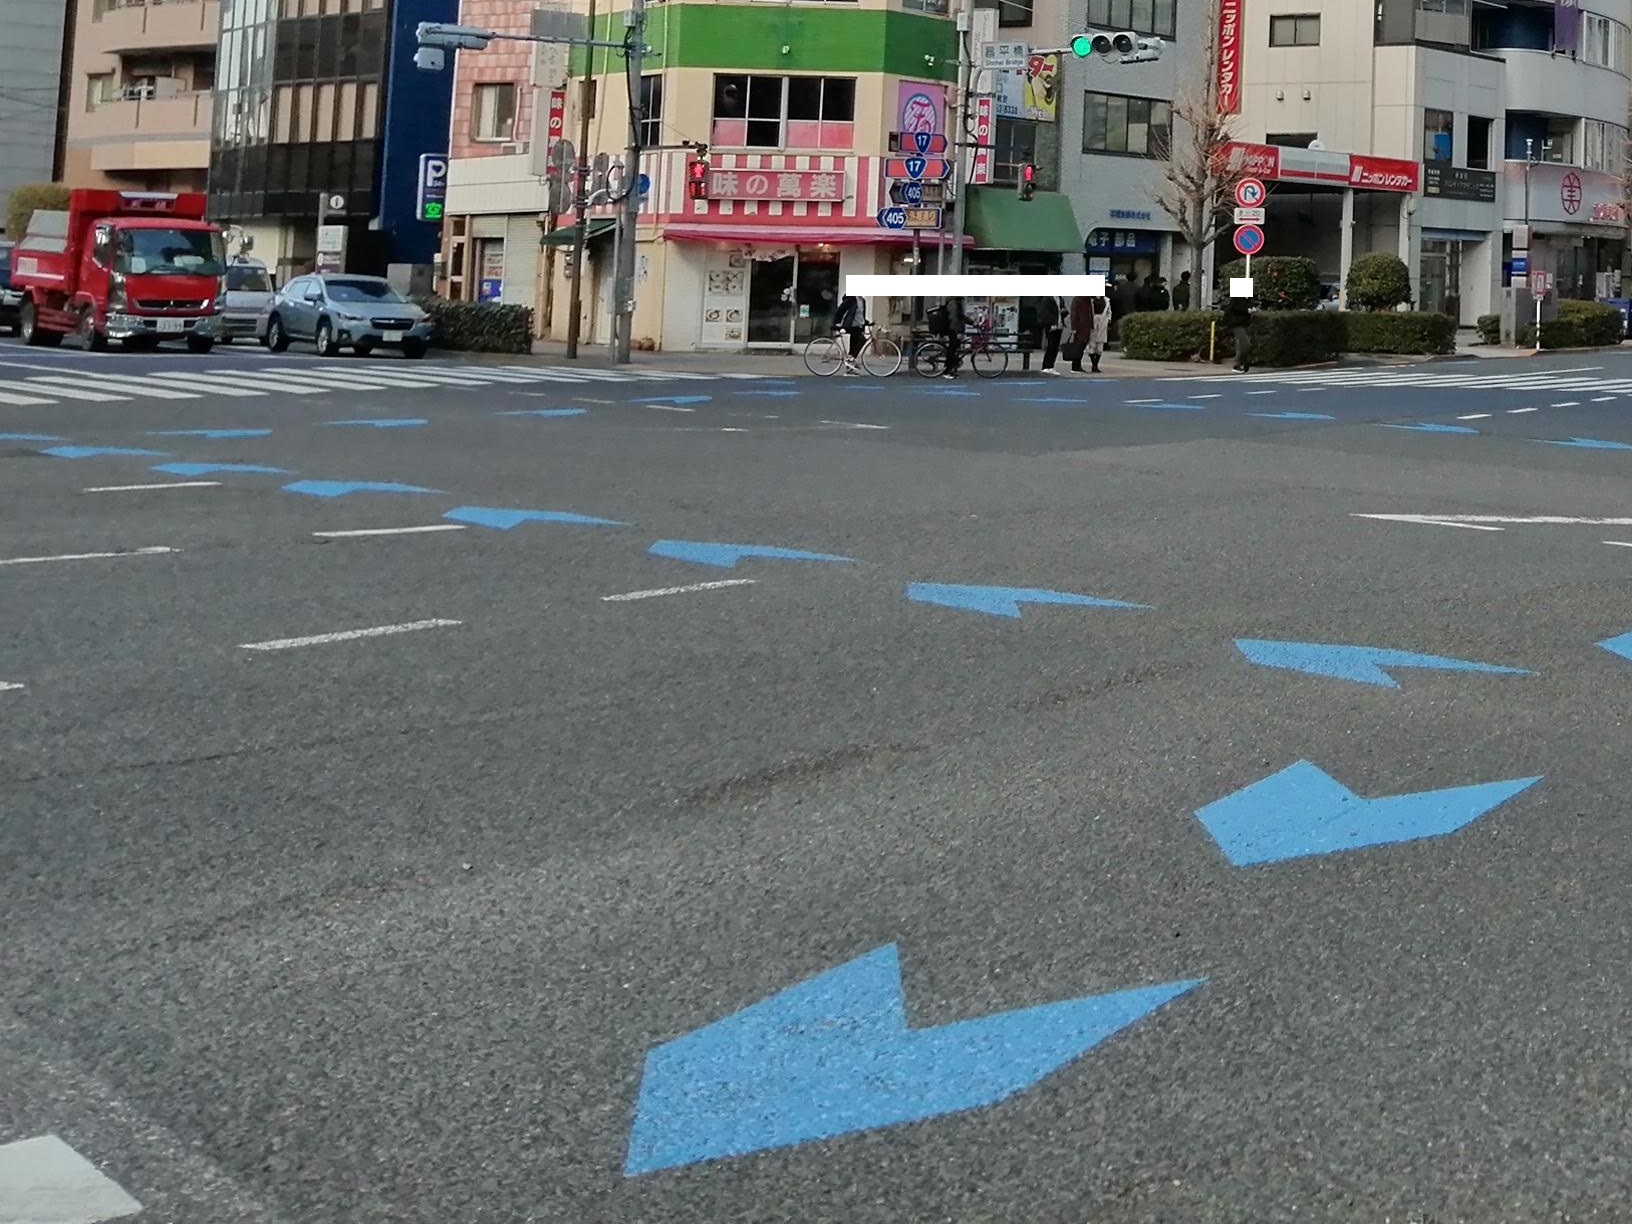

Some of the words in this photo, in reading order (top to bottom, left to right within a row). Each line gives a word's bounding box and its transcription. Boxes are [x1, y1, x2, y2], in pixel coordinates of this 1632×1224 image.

[984, 45, 1024, 57] 昌平橋
[1221, 2, 1237, 107] ニッポンレンタカー
[918, 135, 928, 146] 17
[908, 160, 921, 172] 17
[712, 172, 837, 198] 味の萬楽
[1361, 172, 1413, 187] ニッポンレンタカー
[886, 214, 904, 225] 405
